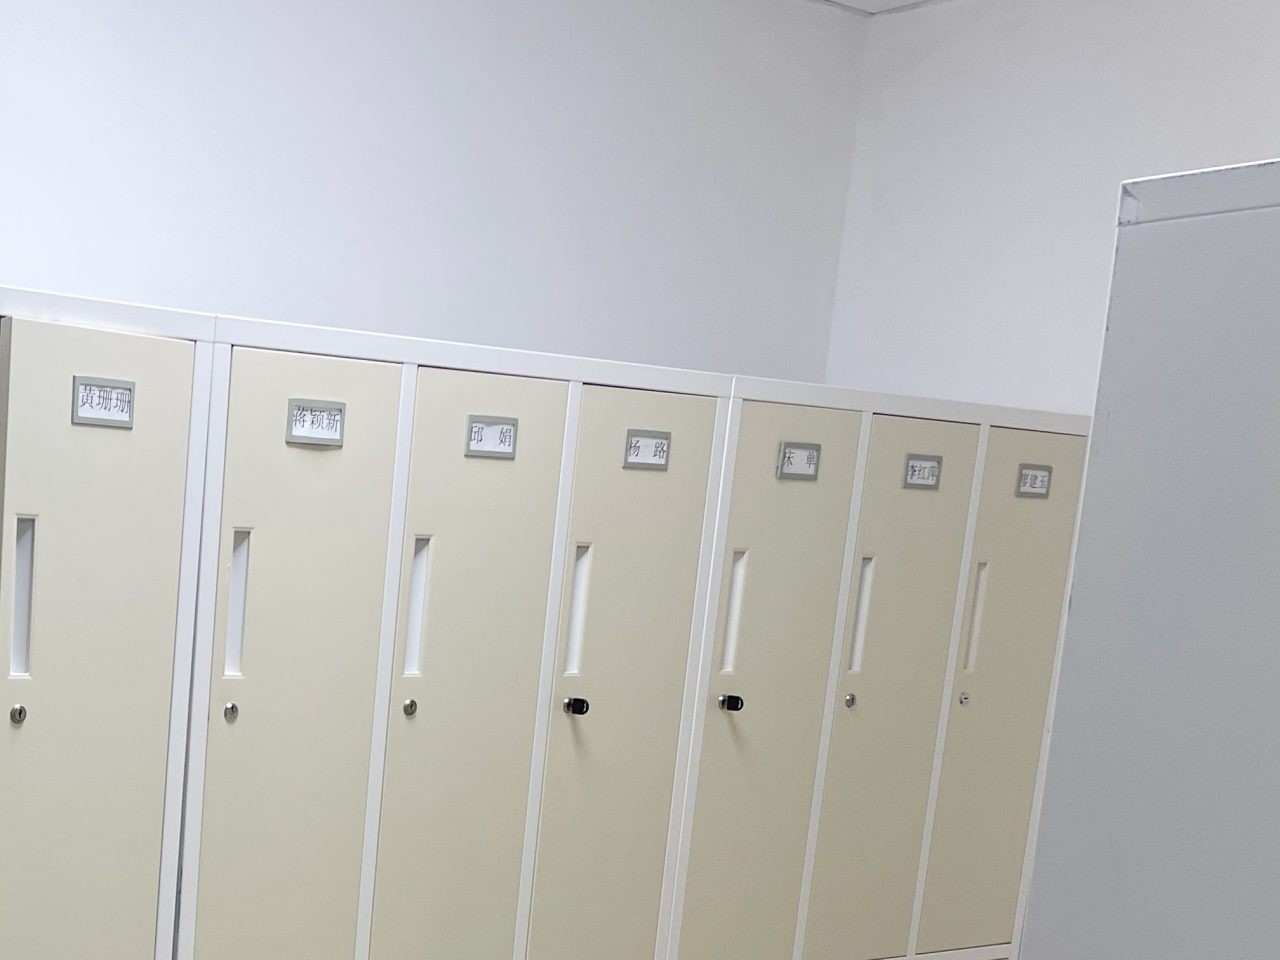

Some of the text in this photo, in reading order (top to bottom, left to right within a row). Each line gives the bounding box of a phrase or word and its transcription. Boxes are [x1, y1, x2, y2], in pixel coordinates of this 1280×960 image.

[79, 385, 130, 414] 黄珊珊
[292, 406, 340, 433] 蒋颖新
